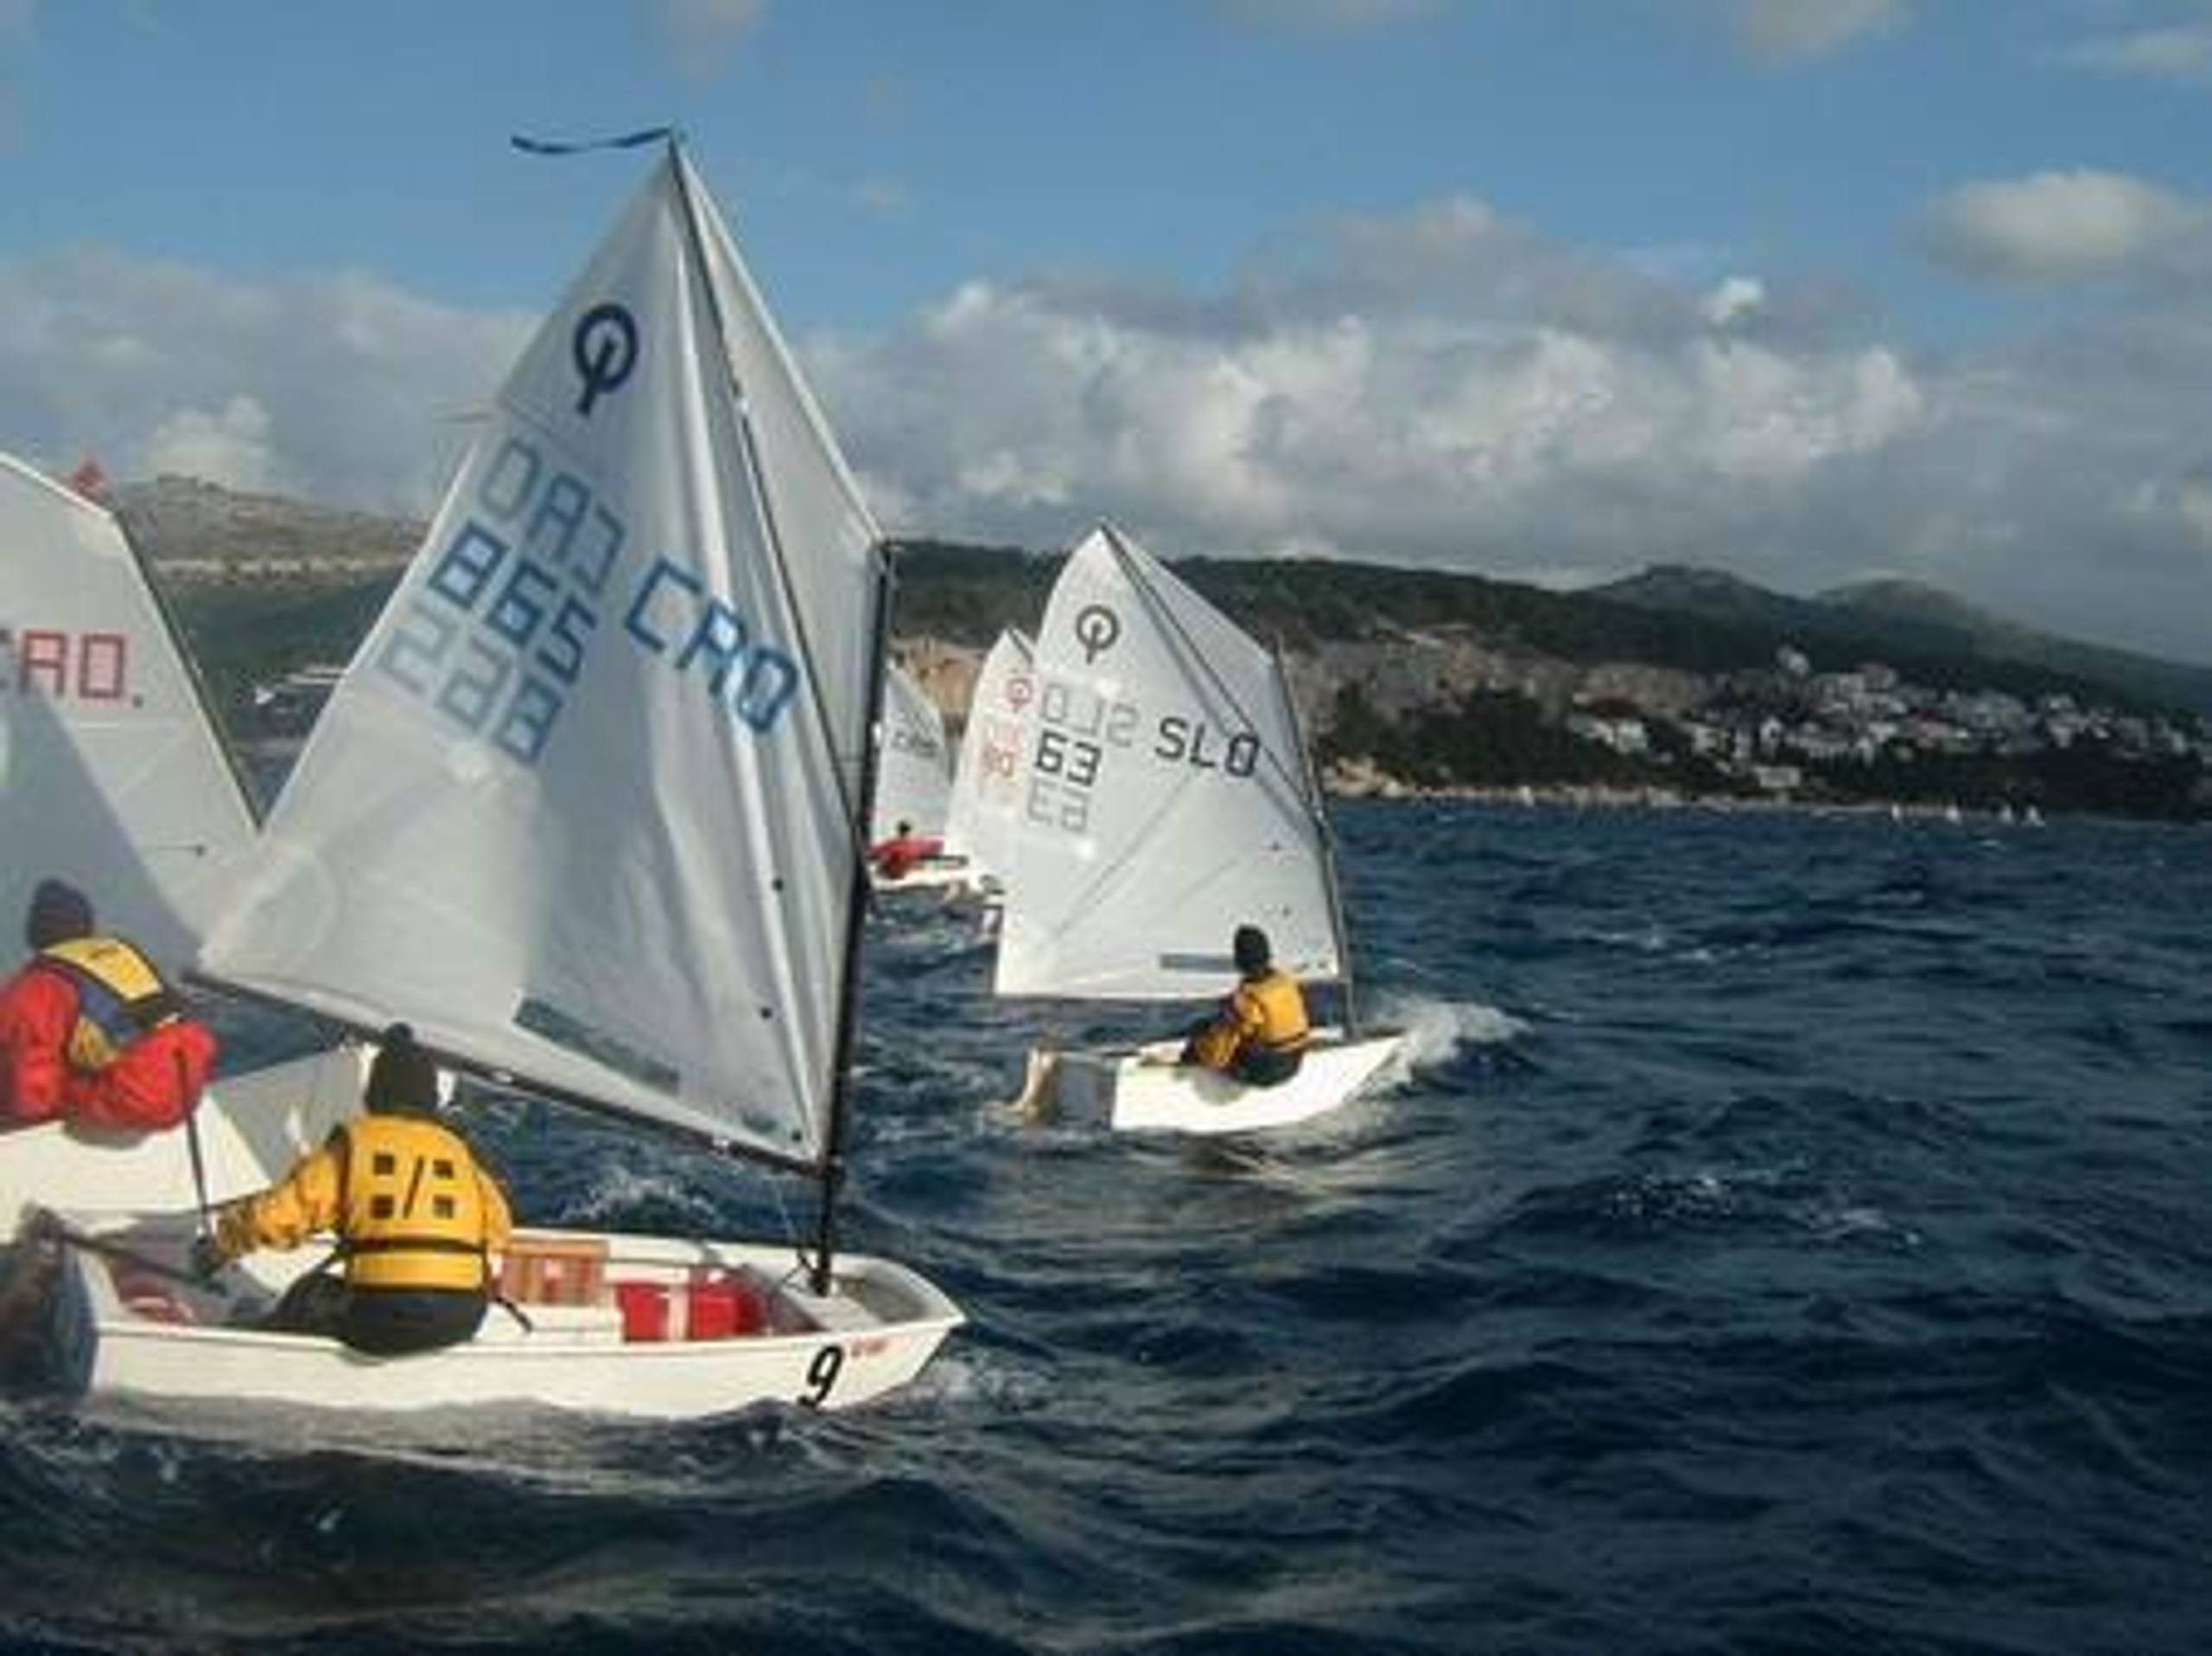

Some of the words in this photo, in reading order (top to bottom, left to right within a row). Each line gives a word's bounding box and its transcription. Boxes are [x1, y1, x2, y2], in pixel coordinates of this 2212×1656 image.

[429, 521, 598, 686] 865
[1034, 731, 1102, 787] 63
[1155, 717, 1261, 777] SLO
[797, 1344, 846, 1410] 9
